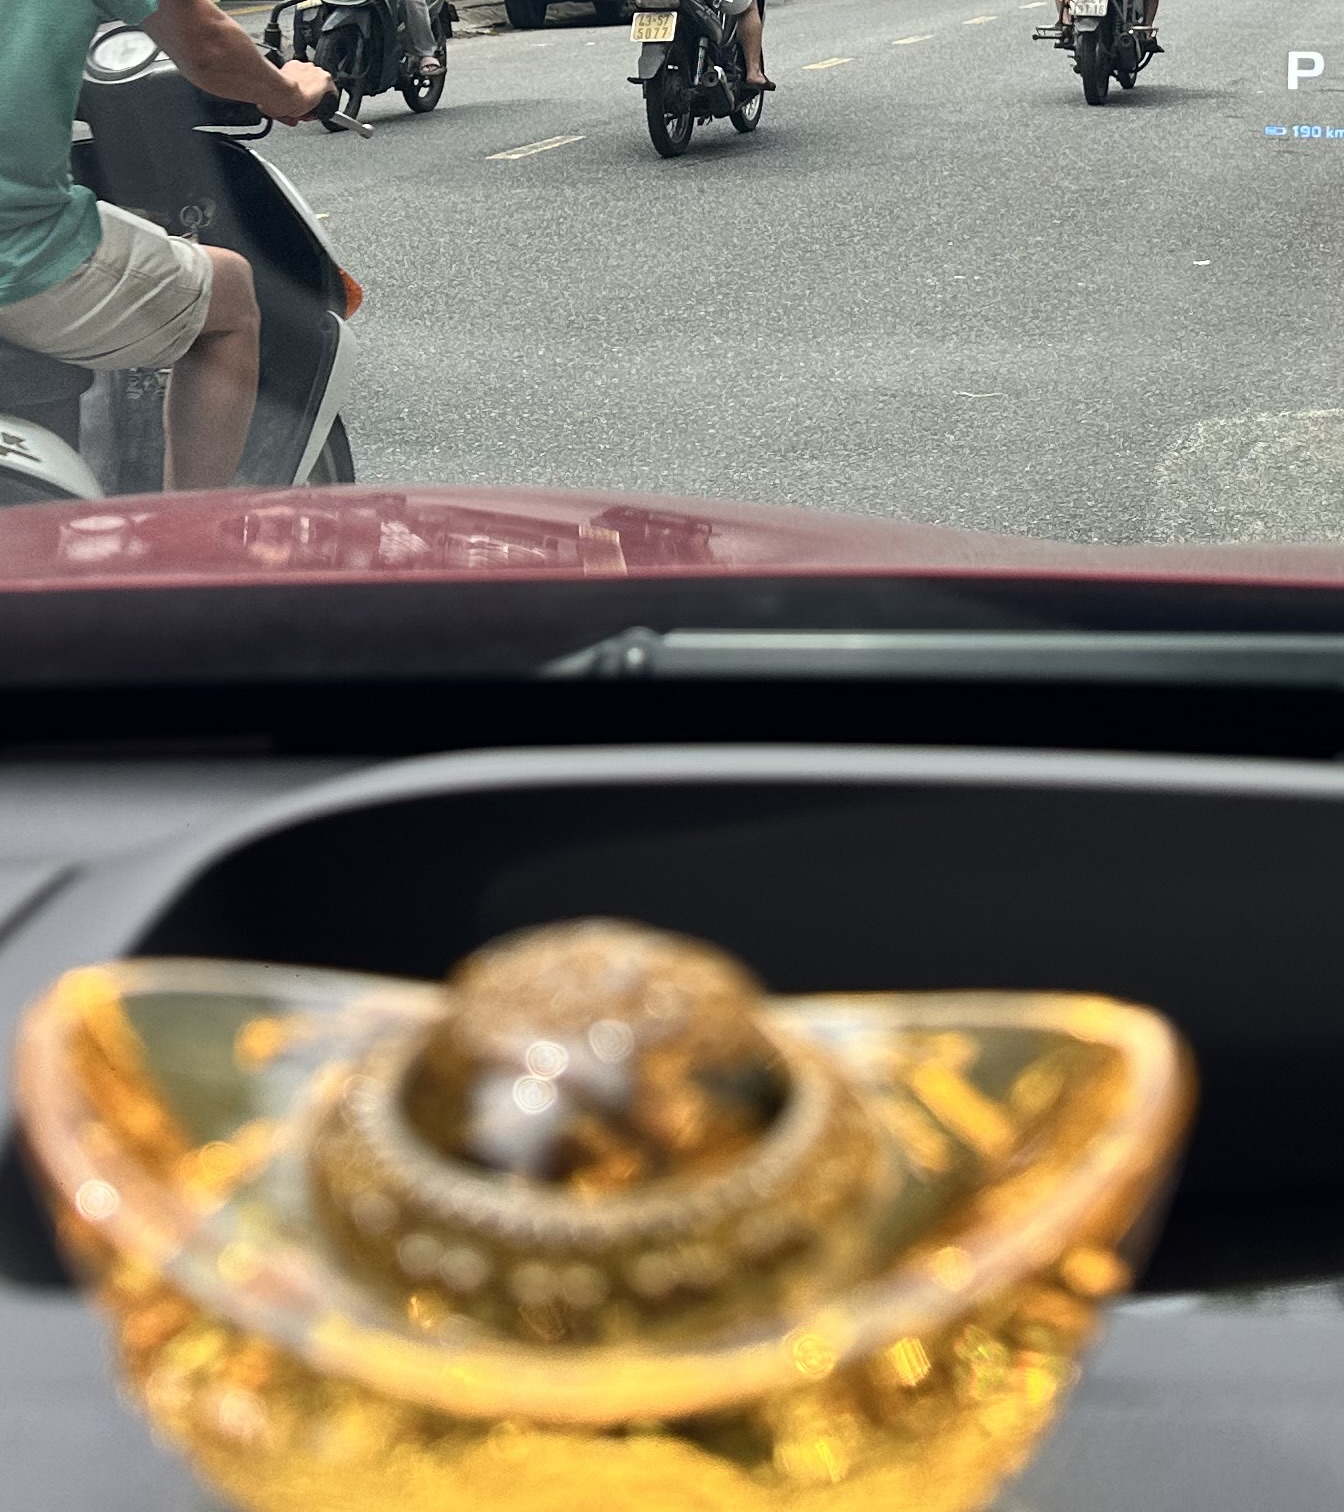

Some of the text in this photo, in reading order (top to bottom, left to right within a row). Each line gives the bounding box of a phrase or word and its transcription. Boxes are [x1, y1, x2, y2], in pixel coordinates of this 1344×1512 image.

[637, 27, 668, 39] 5077
[1288, 51, 1324, 89] P
[1292, 125, 1322, 138] 190
